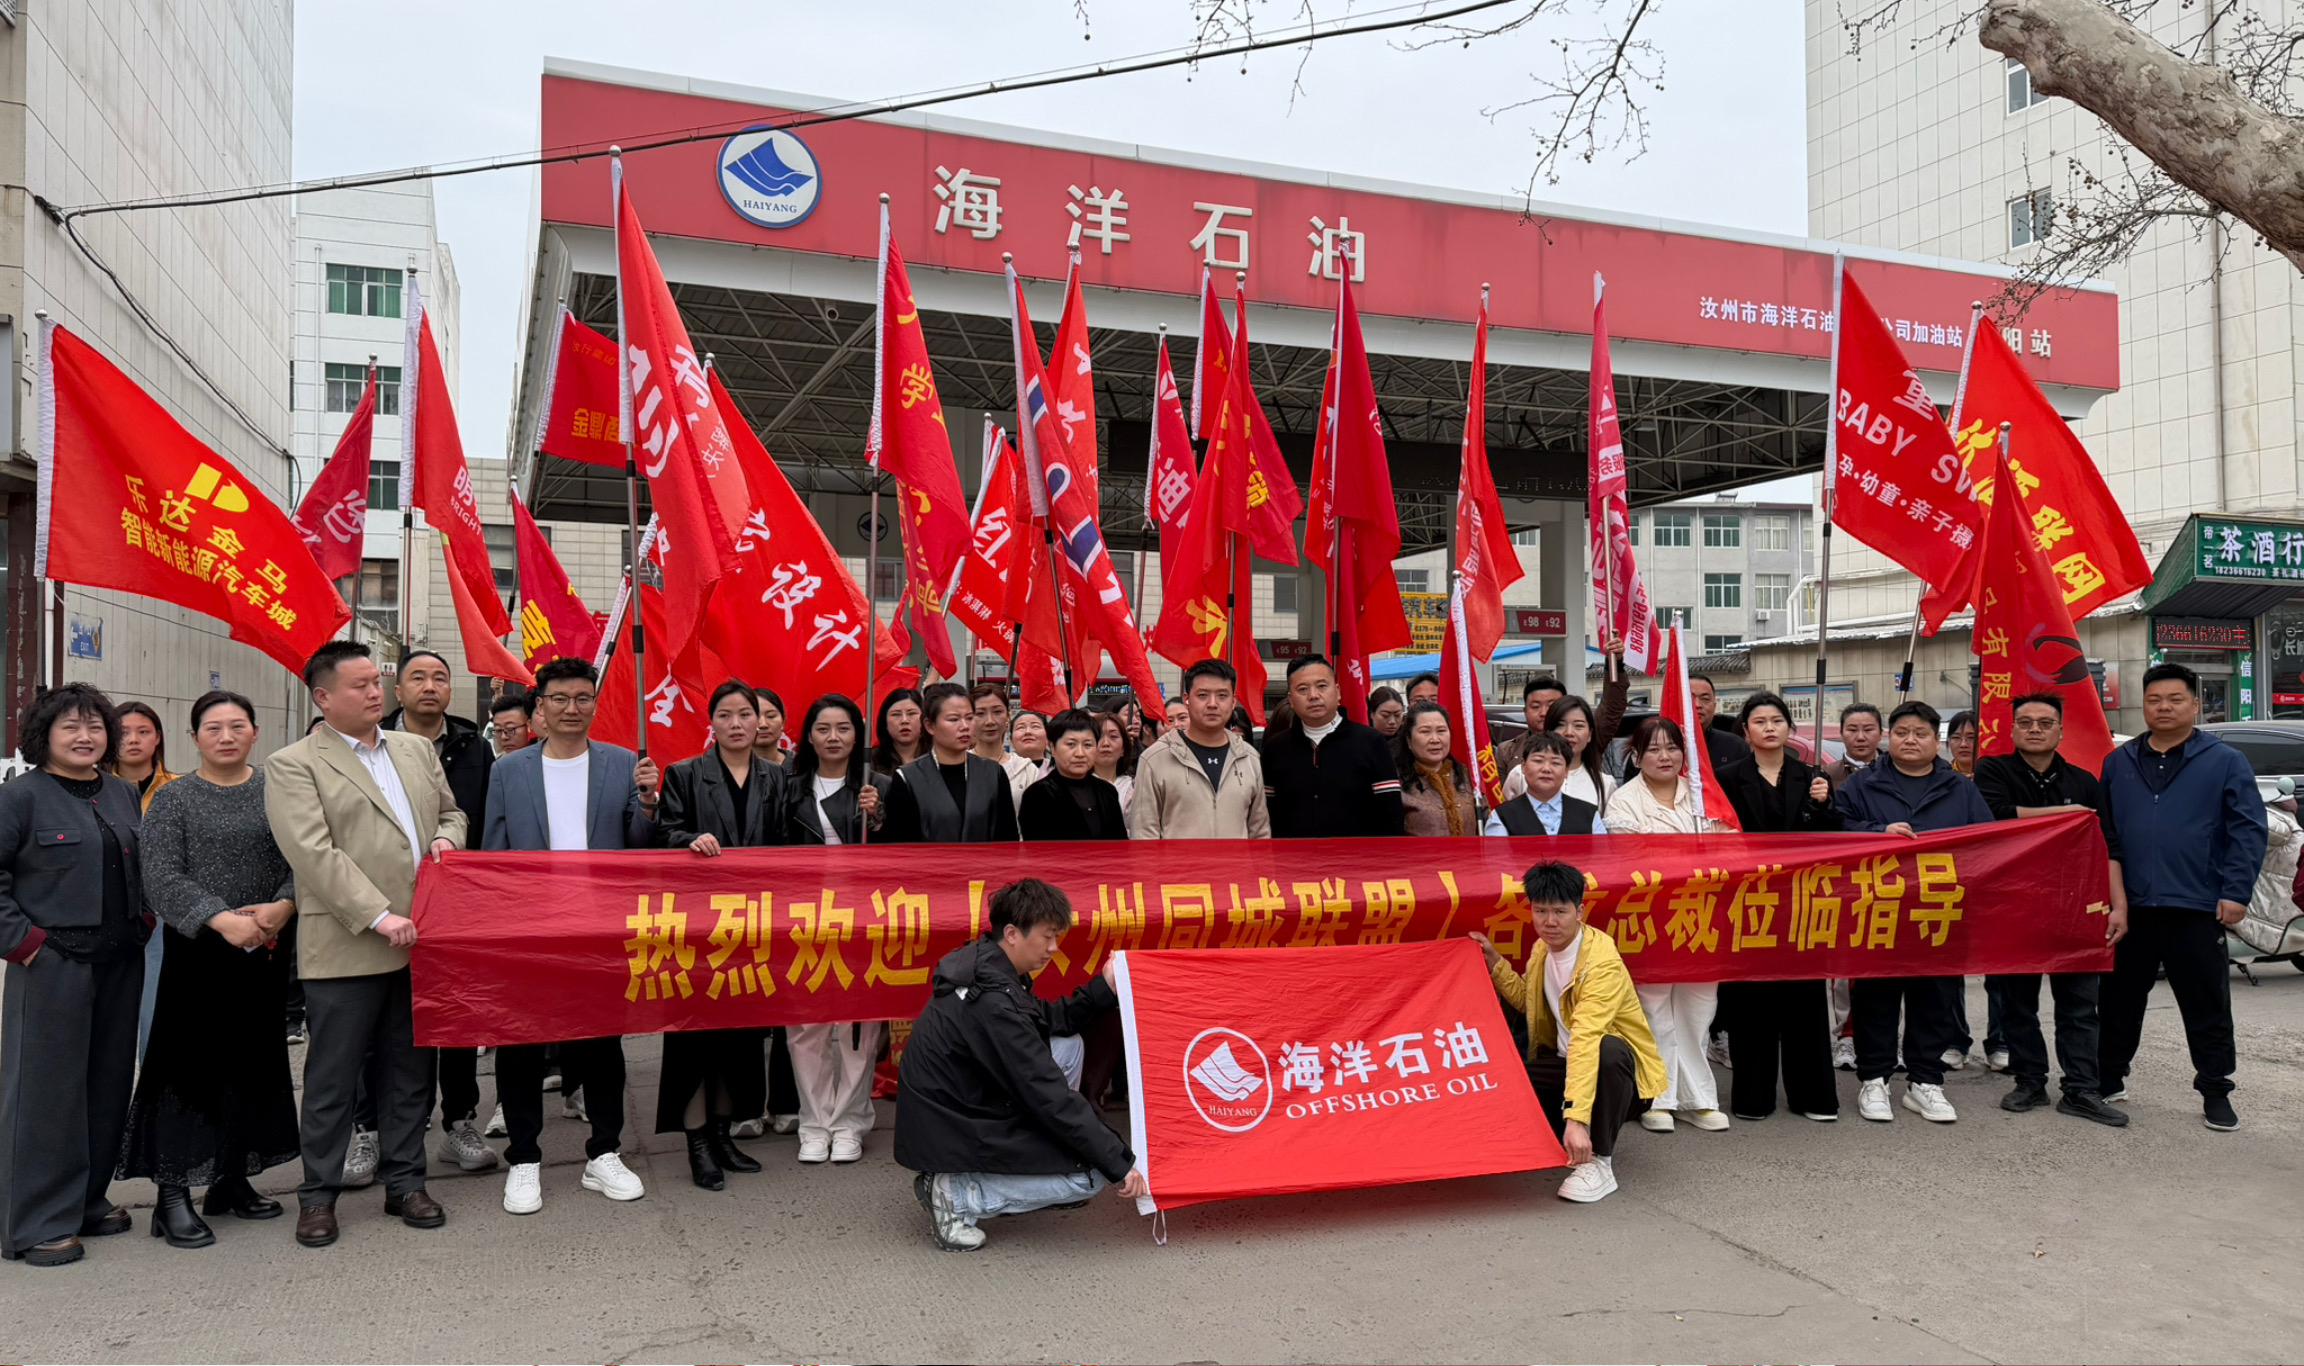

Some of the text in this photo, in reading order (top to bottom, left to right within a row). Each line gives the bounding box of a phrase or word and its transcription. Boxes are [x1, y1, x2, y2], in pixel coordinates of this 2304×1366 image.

[743, 199, 797, 213] HAIYANG
[934, 165, 1366, 283] 海洋石油
[1837, 388, 1917, 457] BABY
[121, 507, 297, 631] 智能新能源汽车城
[125, 474, 288, 595] 乐达金马
[2220, 525, 2304, 565] 茶酒行
[1279, 1021, 1490, 1094] 海洋石油
[1208, 1104, 1258, 1118] HAIYANG
[1285, 1072, 1498, 1119] OFFSHORE OIL
